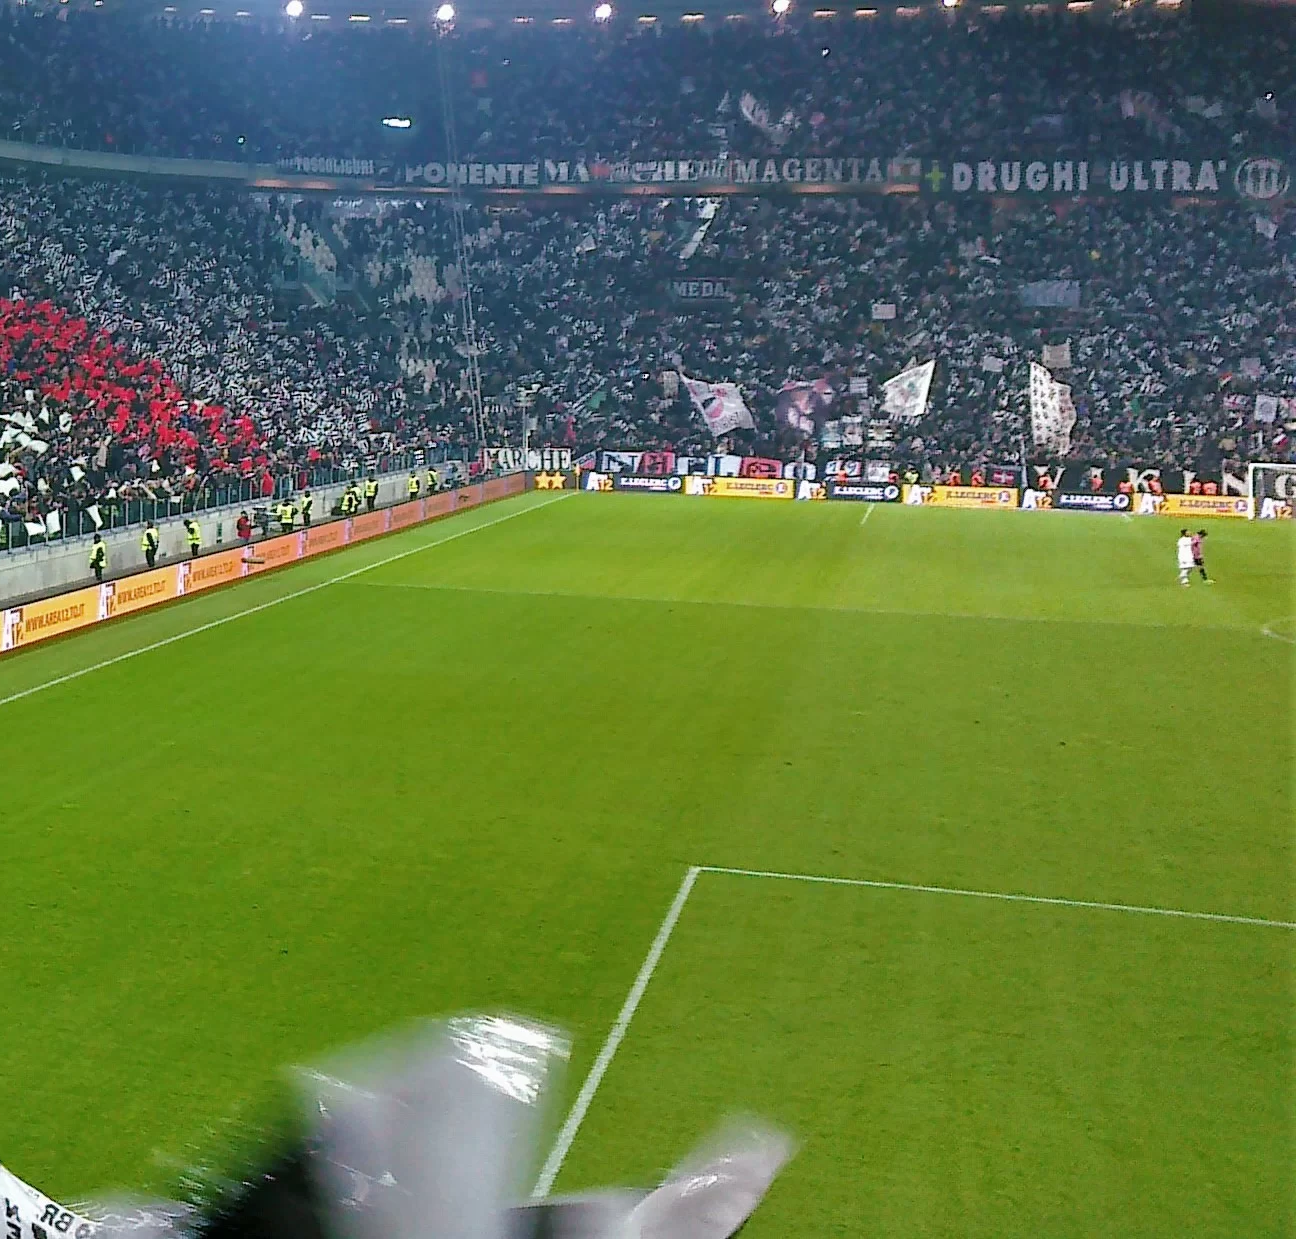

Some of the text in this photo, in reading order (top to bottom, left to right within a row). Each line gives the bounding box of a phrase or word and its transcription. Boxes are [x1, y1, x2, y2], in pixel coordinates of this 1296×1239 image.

[734, 157, 883, 183] MAGENTA
[952, 160, 1089, 192] DRUGHI
[1110, 159, 1227, 191] ULTRA'
